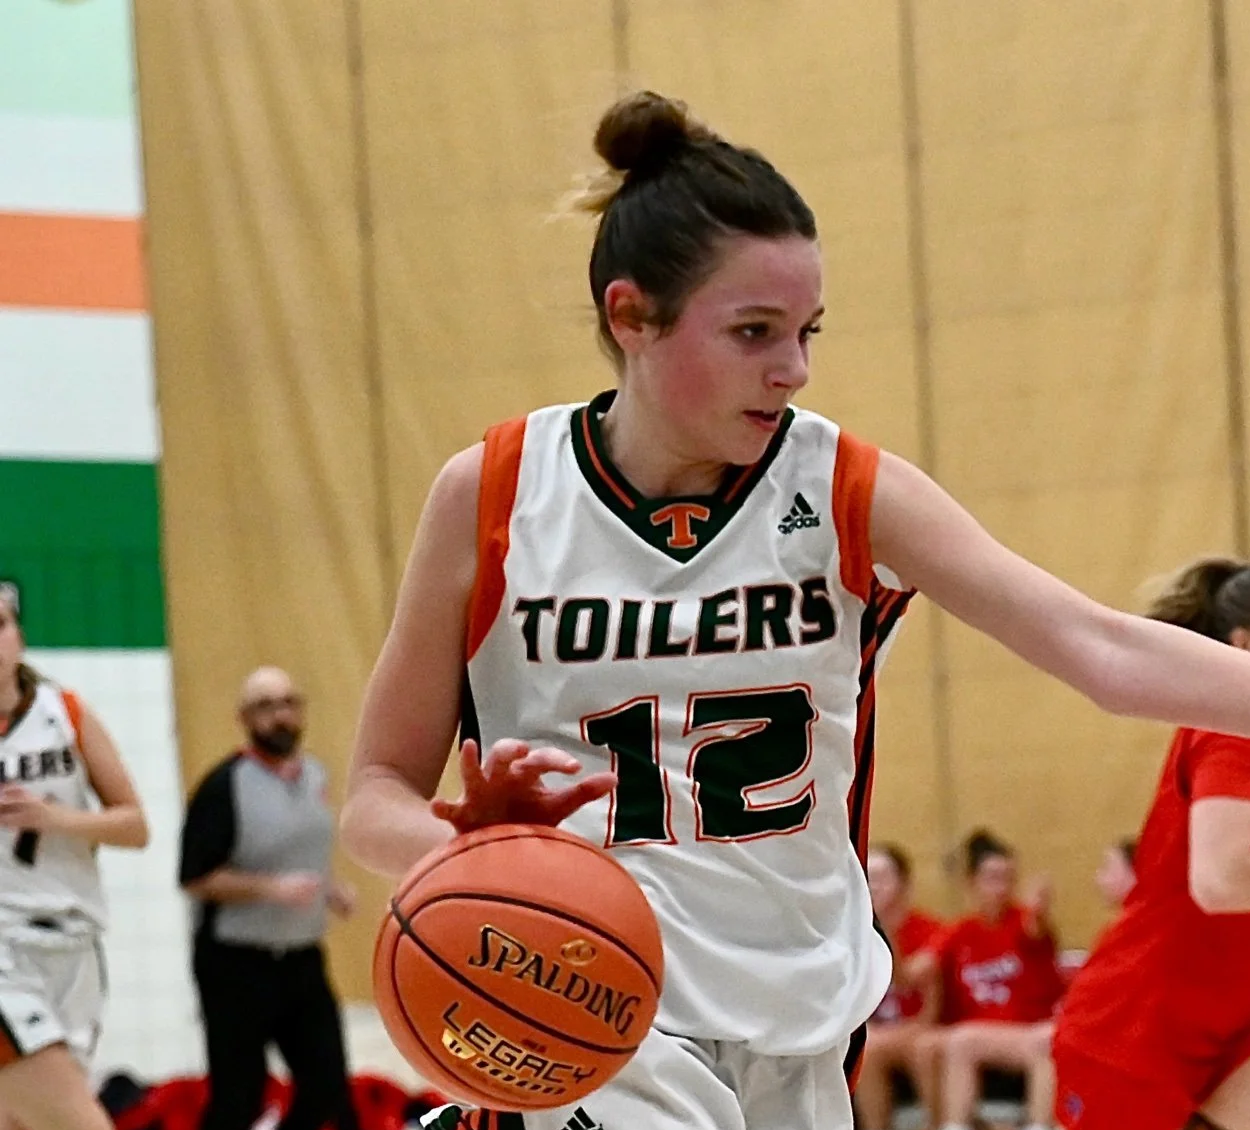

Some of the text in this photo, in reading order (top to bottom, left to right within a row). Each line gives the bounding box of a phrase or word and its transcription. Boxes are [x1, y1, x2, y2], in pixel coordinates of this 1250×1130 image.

[650, 503, 710, 548] T
[512, 576, 838, 663] TOILERS
[580, 683, 819, 848] 12
[468, 924, 642, 1037] SPALDING
[442, 1001, 597, 1084] LEGACY
